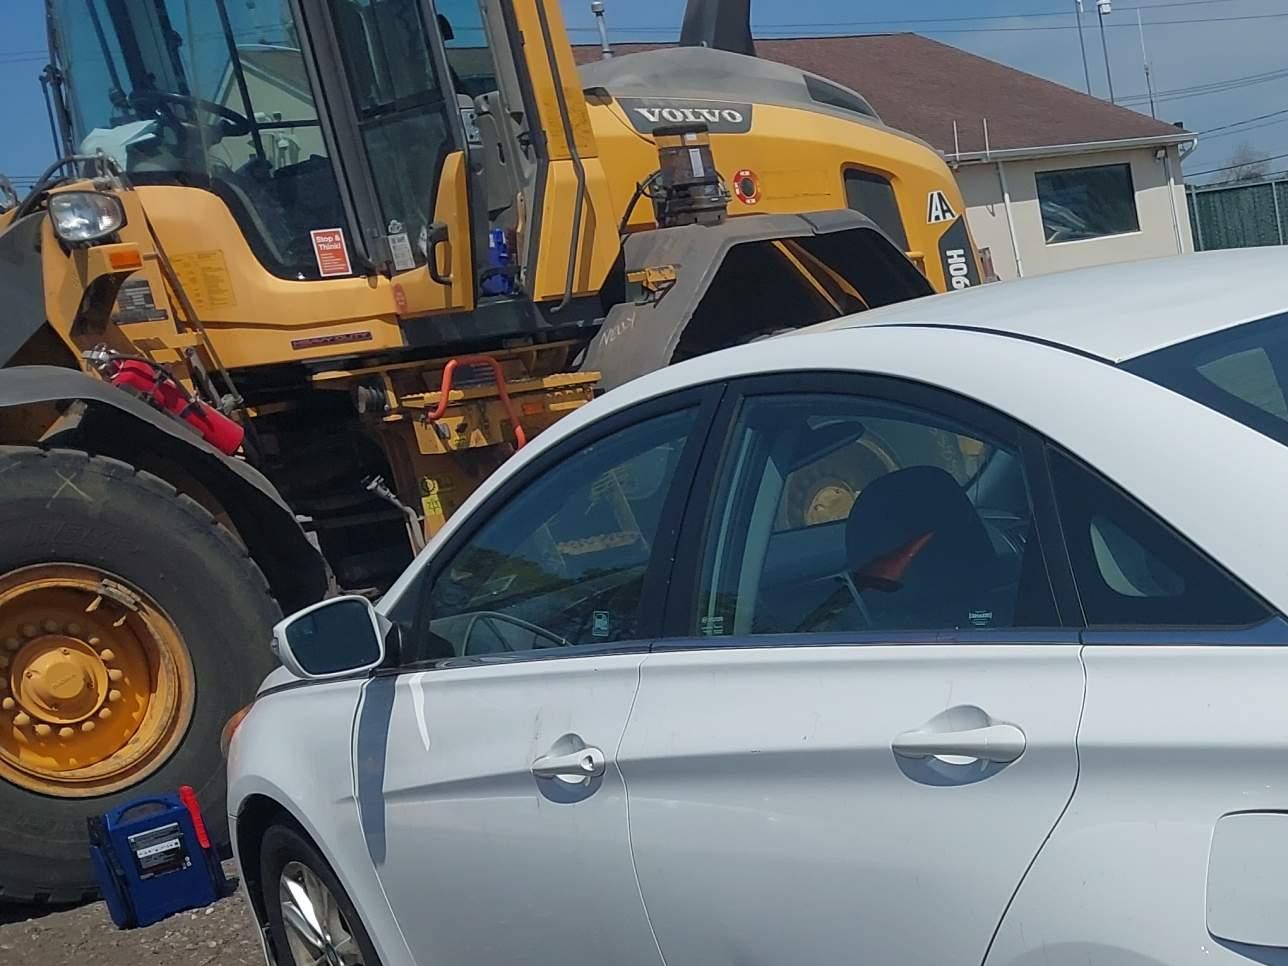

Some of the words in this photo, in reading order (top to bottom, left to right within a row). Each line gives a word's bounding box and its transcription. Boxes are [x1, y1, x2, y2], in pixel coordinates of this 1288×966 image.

[633, 107, 743, 123] VOLVO
[316, 236, 334, 244] Stop
[318, 243, 341, 251] Think!
